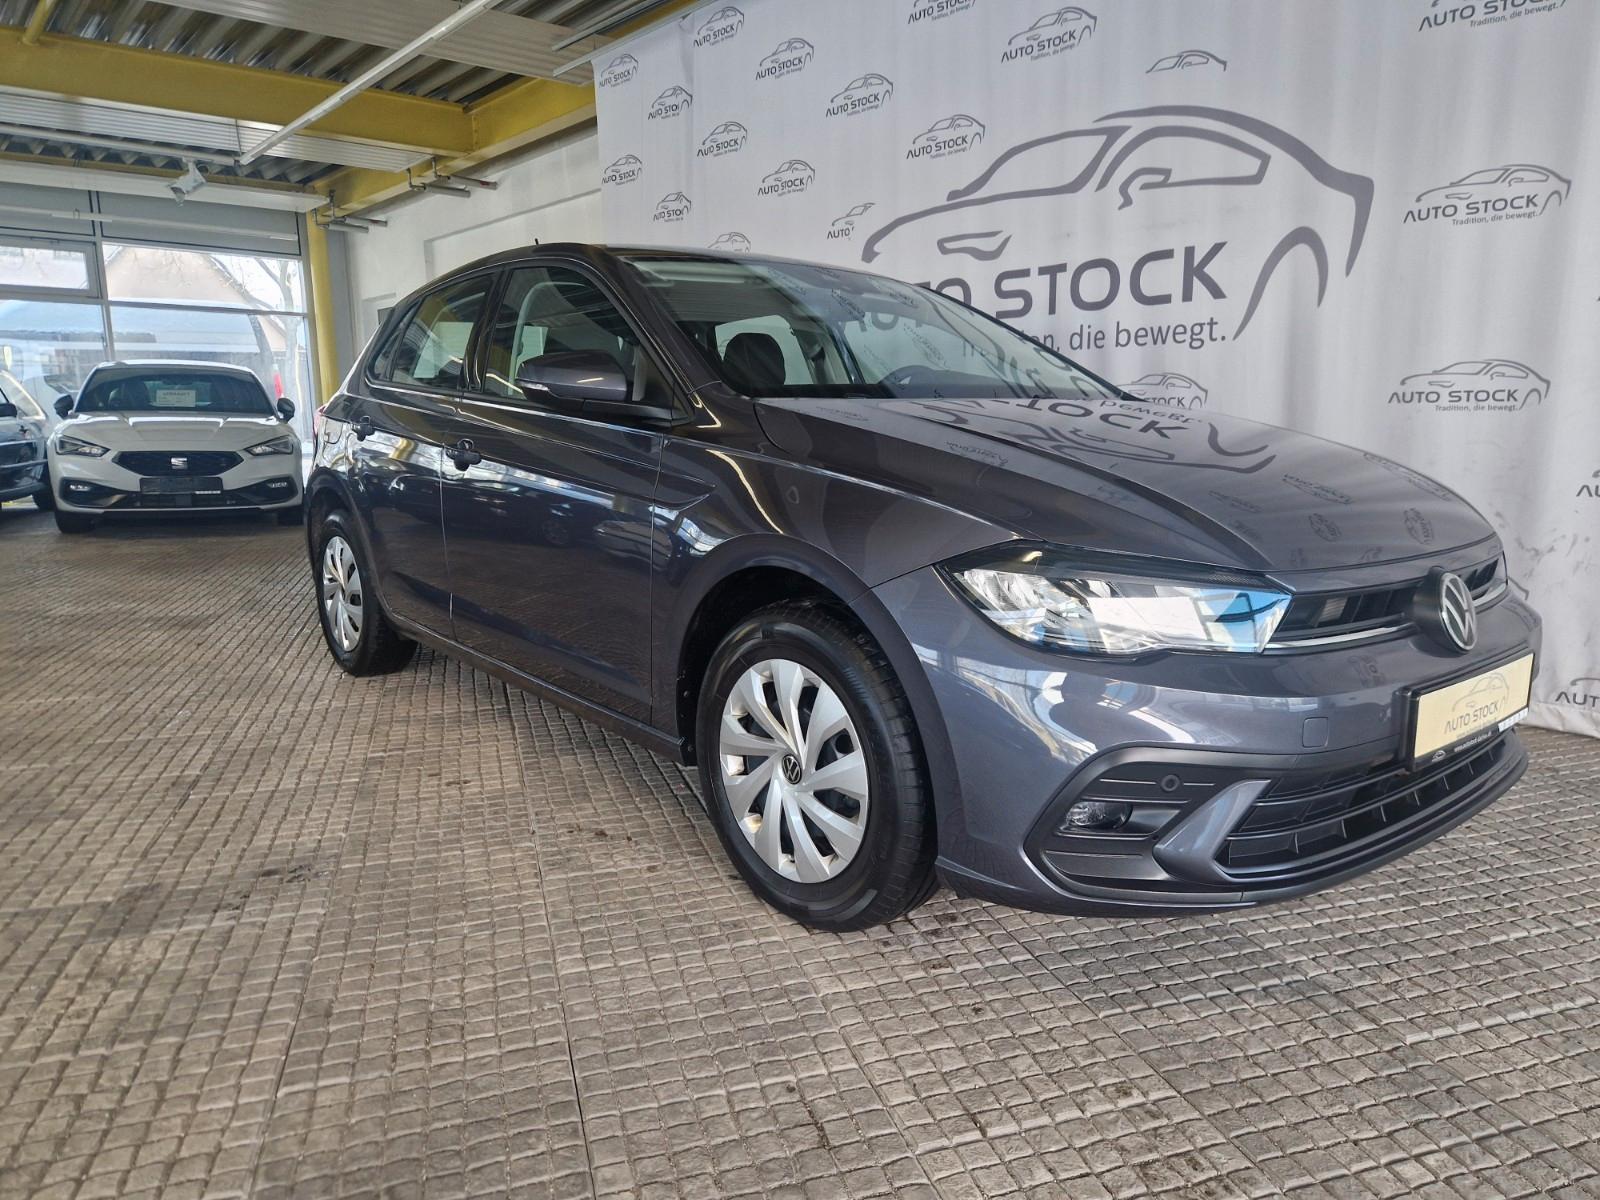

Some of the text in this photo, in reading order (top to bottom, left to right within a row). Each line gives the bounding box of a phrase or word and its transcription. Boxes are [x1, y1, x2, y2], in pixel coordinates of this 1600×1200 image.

[907, 5, 934, 25] AUTO
[936, 0, 967, 13] STO
[1418, 0, 1550, 32] AUTO STO
[1509, 9, 1522, 20] die
[712, 23, 735, 40] STOCK
[1001, 29, 1077, 63] AUTO STOCK
[755, 65, 777, 81] AUTO
[777, 56, 803, 72] STOCK
[825, 102, 849, 118] AUTO
[850, 92, 880, 110] STOCK
[715, 138, 739, 151] STOCK
[906, 143, 933, 160] AUTO
[934, 134, 968, 152] STOCK
[757, 183, 780, 196] AUTO
[780, 176, 805, 192] STOCK
[1403, 193, 1539, 224] AUTO STOCK
[1452, 210, 1539, 226] Tradition, die bewegt.
[827, 228, 851, 240] AUTO
[995, 241, 1228, 320] STOCK
[1069, 323, 1105, 351] die
[1114, 316, 1227, 350] bewegt.
[1388, 388, 1519, 404] AUTO STOCK
[1435, 403, 1519, 412] Tradition, die bewegt.
[1444, 712, 1472, 735] AUTO
[1472, 700, 1499, 723] STOCK
